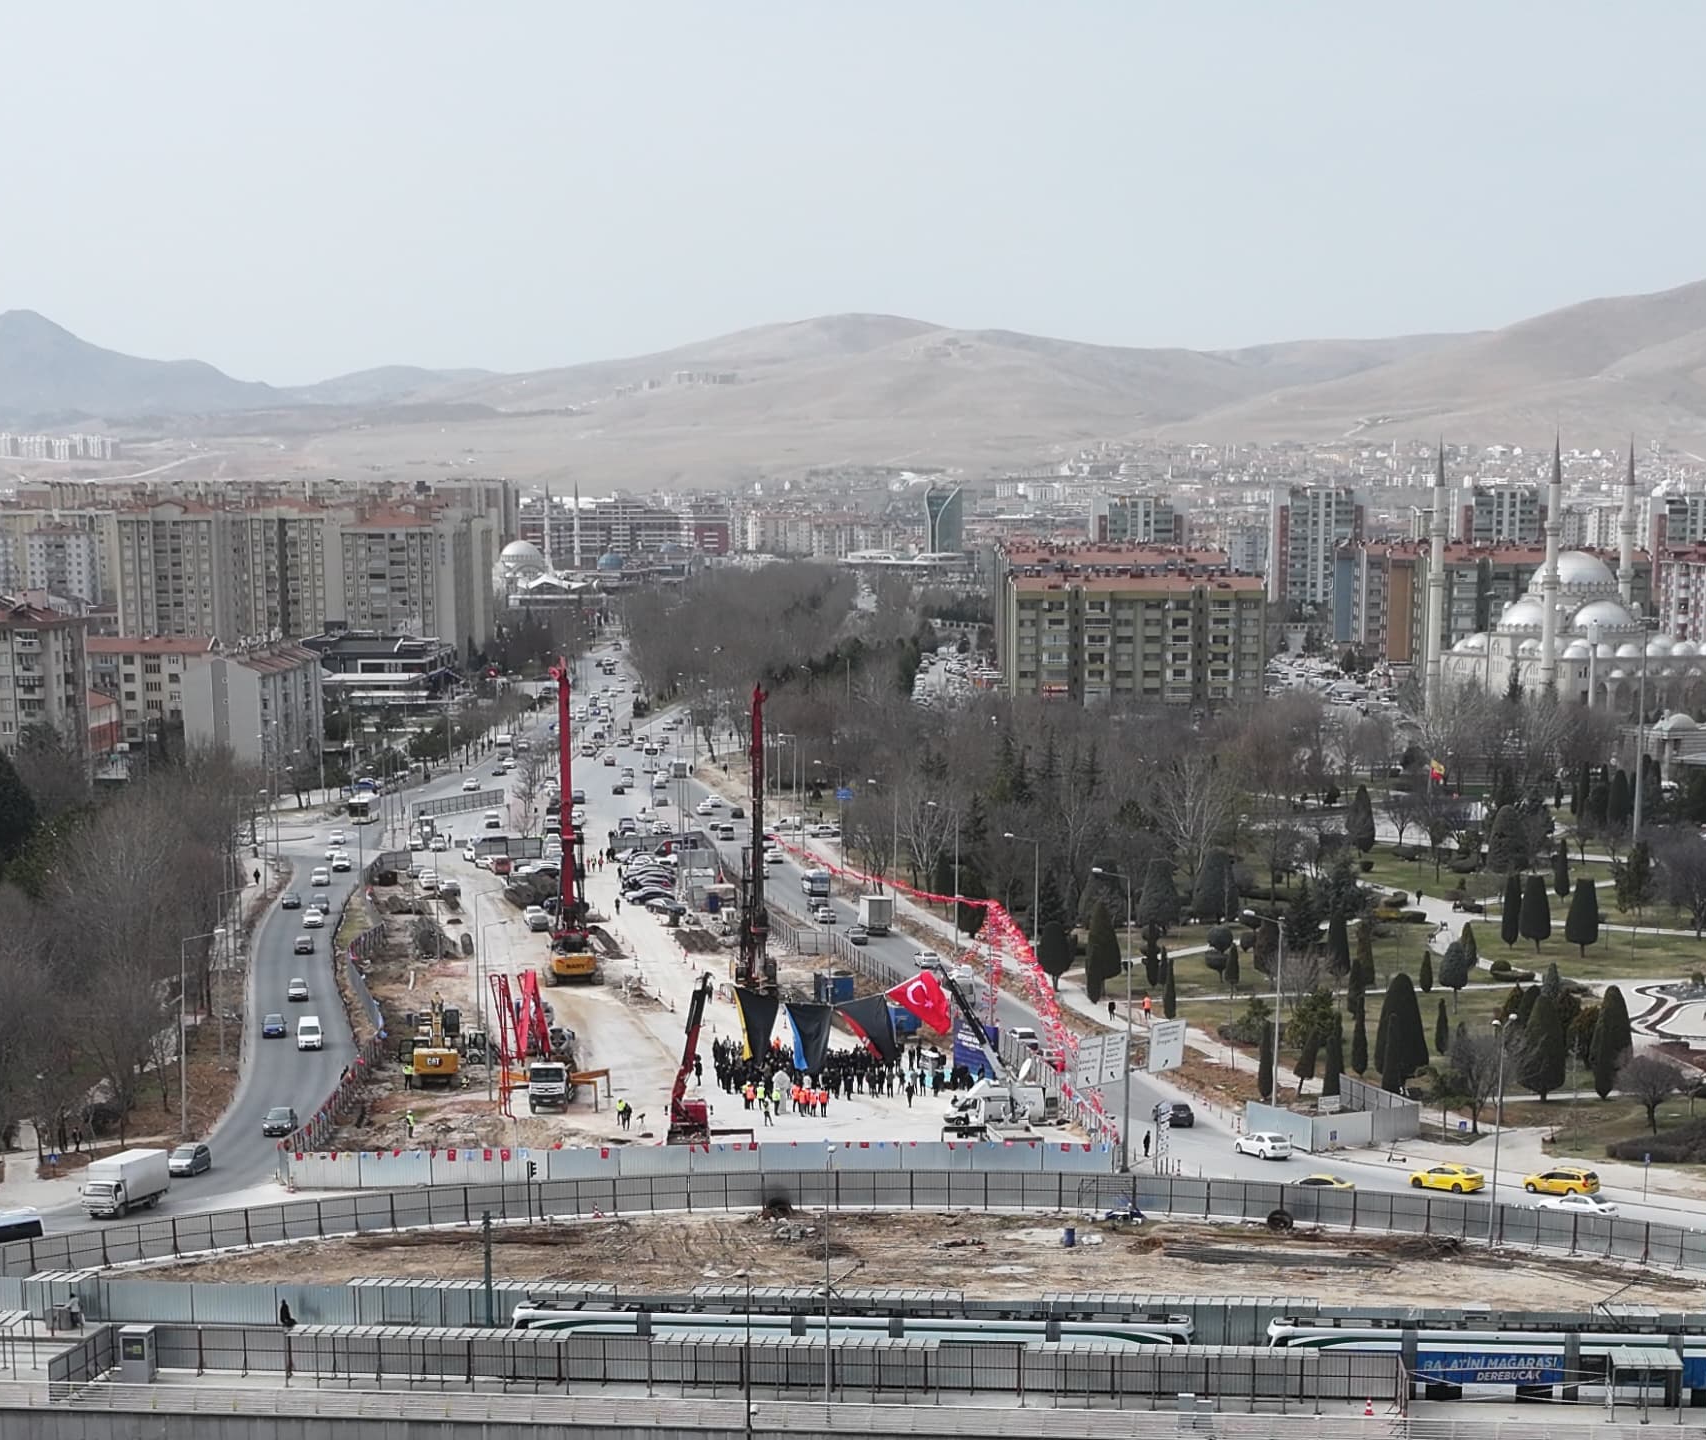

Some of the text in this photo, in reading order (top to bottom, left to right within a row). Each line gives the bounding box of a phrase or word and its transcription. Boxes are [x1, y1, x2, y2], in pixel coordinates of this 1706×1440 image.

[426, 1057, 441, 1066] CAT
[1488, 1355, 1557, 1369] MAĞARASI
[1476, 1370, 1542, 1382] DEREBUCAK
